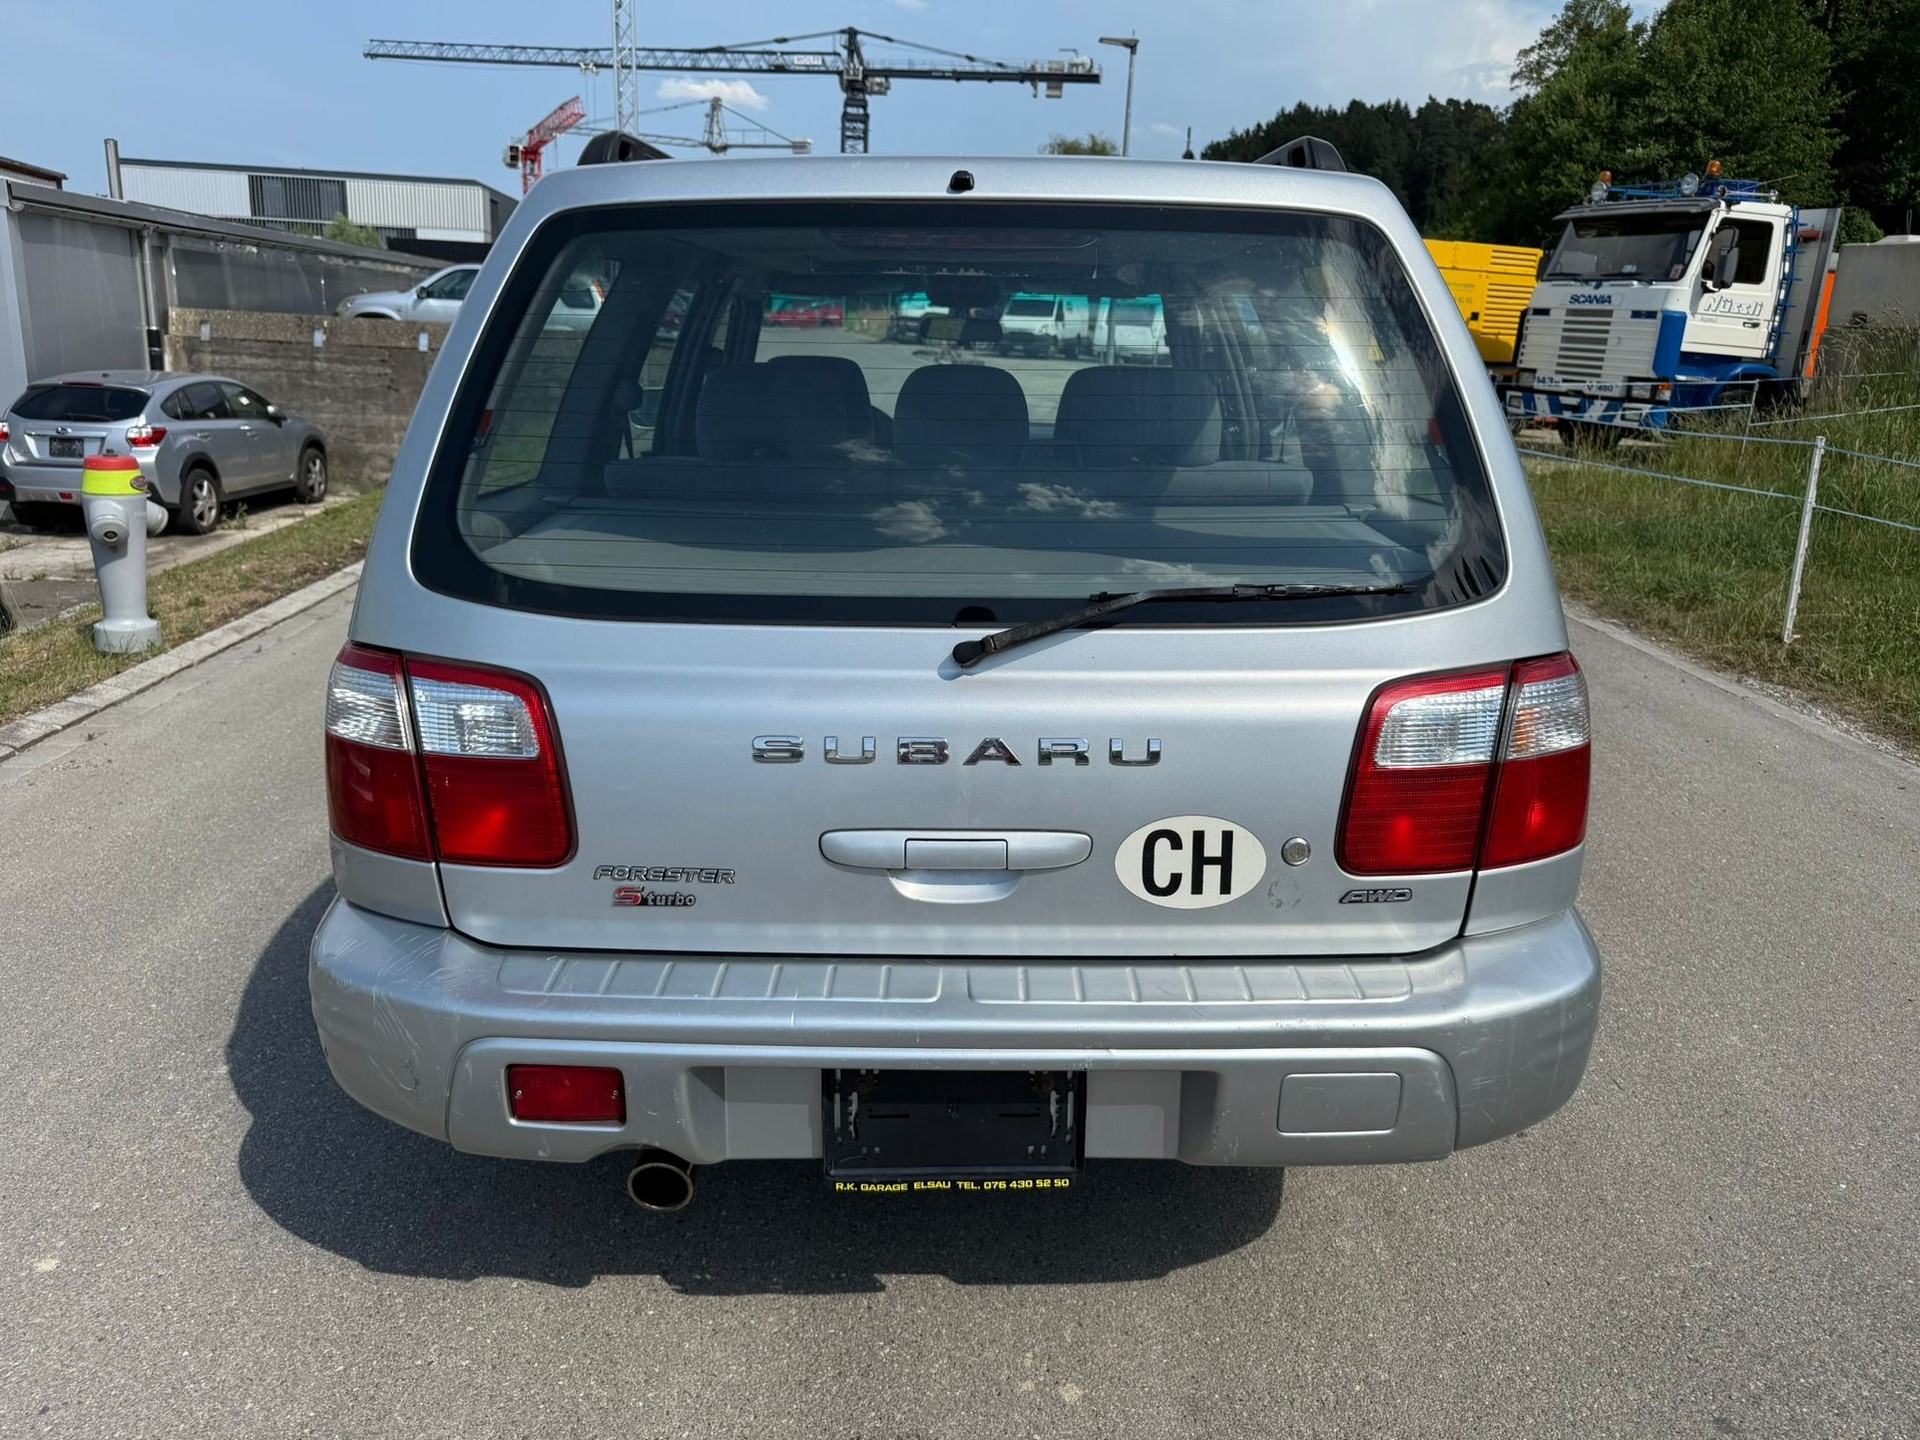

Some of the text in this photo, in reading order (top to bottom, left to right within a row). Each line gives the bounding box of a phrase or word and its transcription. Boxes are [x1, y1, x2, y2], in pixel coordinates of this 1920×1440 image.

[1568, 294, 1612, 304] SCANIA
[1704, 294, 1763, 317] Nüssli
[751, 735, 1162, 767] SUBARU
[1141, 828, 1234, 897] CH
[593, 864, 736, 884] FORESTER
[645, 891, 697, 907] turbo
[1339, 888, 1413, 904] AWD
[835, 1178, 1070, 1192] R.K. GARAGE ELSAU TEL. 076 430 52 50
